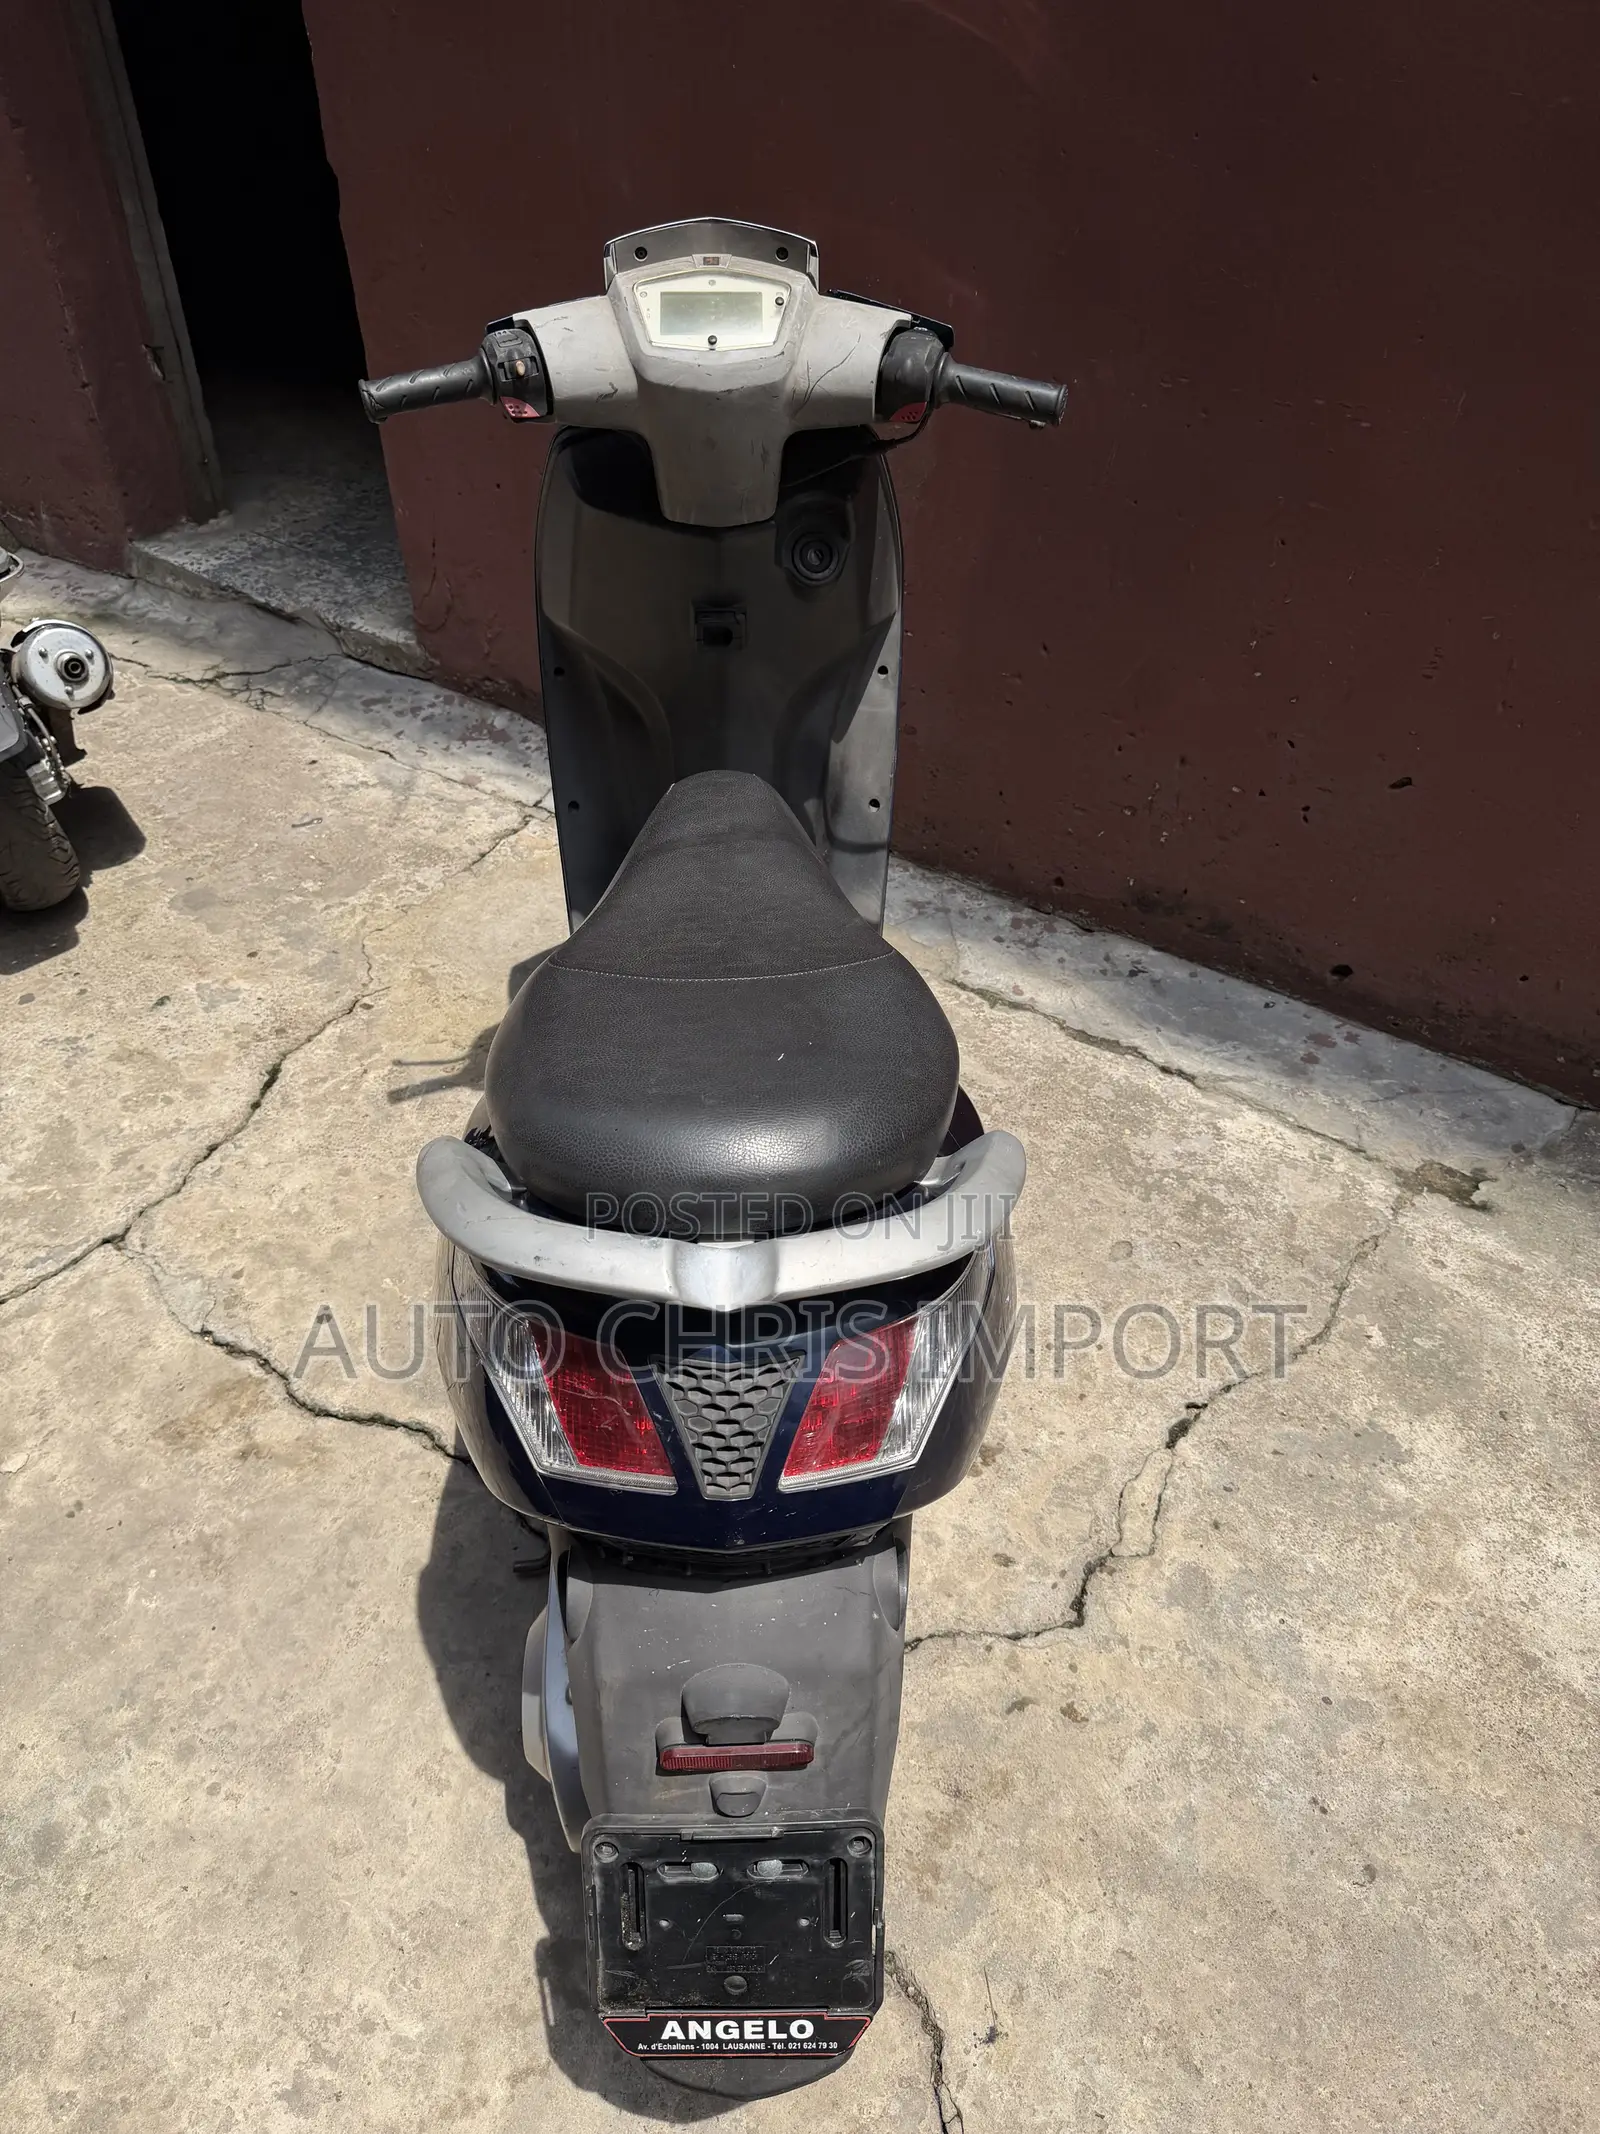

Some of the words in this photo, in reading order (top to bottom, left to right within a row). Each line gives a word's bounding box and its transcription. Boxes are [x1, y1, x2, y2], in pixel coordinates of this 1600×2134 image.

[660, 2019, 815, 2040] ANGELO
[637, 2042, 650, 2050] Av.
[650, 2042, 695, 2050] d'Echallens
[701, 2042, 719, 2050] 1004
[722, 2042, 766, 2050] LAUSANNE
[772, 2041, 787, 2049] Tél.
[788, 2042, 801, 2050] 021
[803, 2041, 817, 2049] 624
[818, 2041, 828, 2049] 79
[828, 2041, 838, 2049] 30
